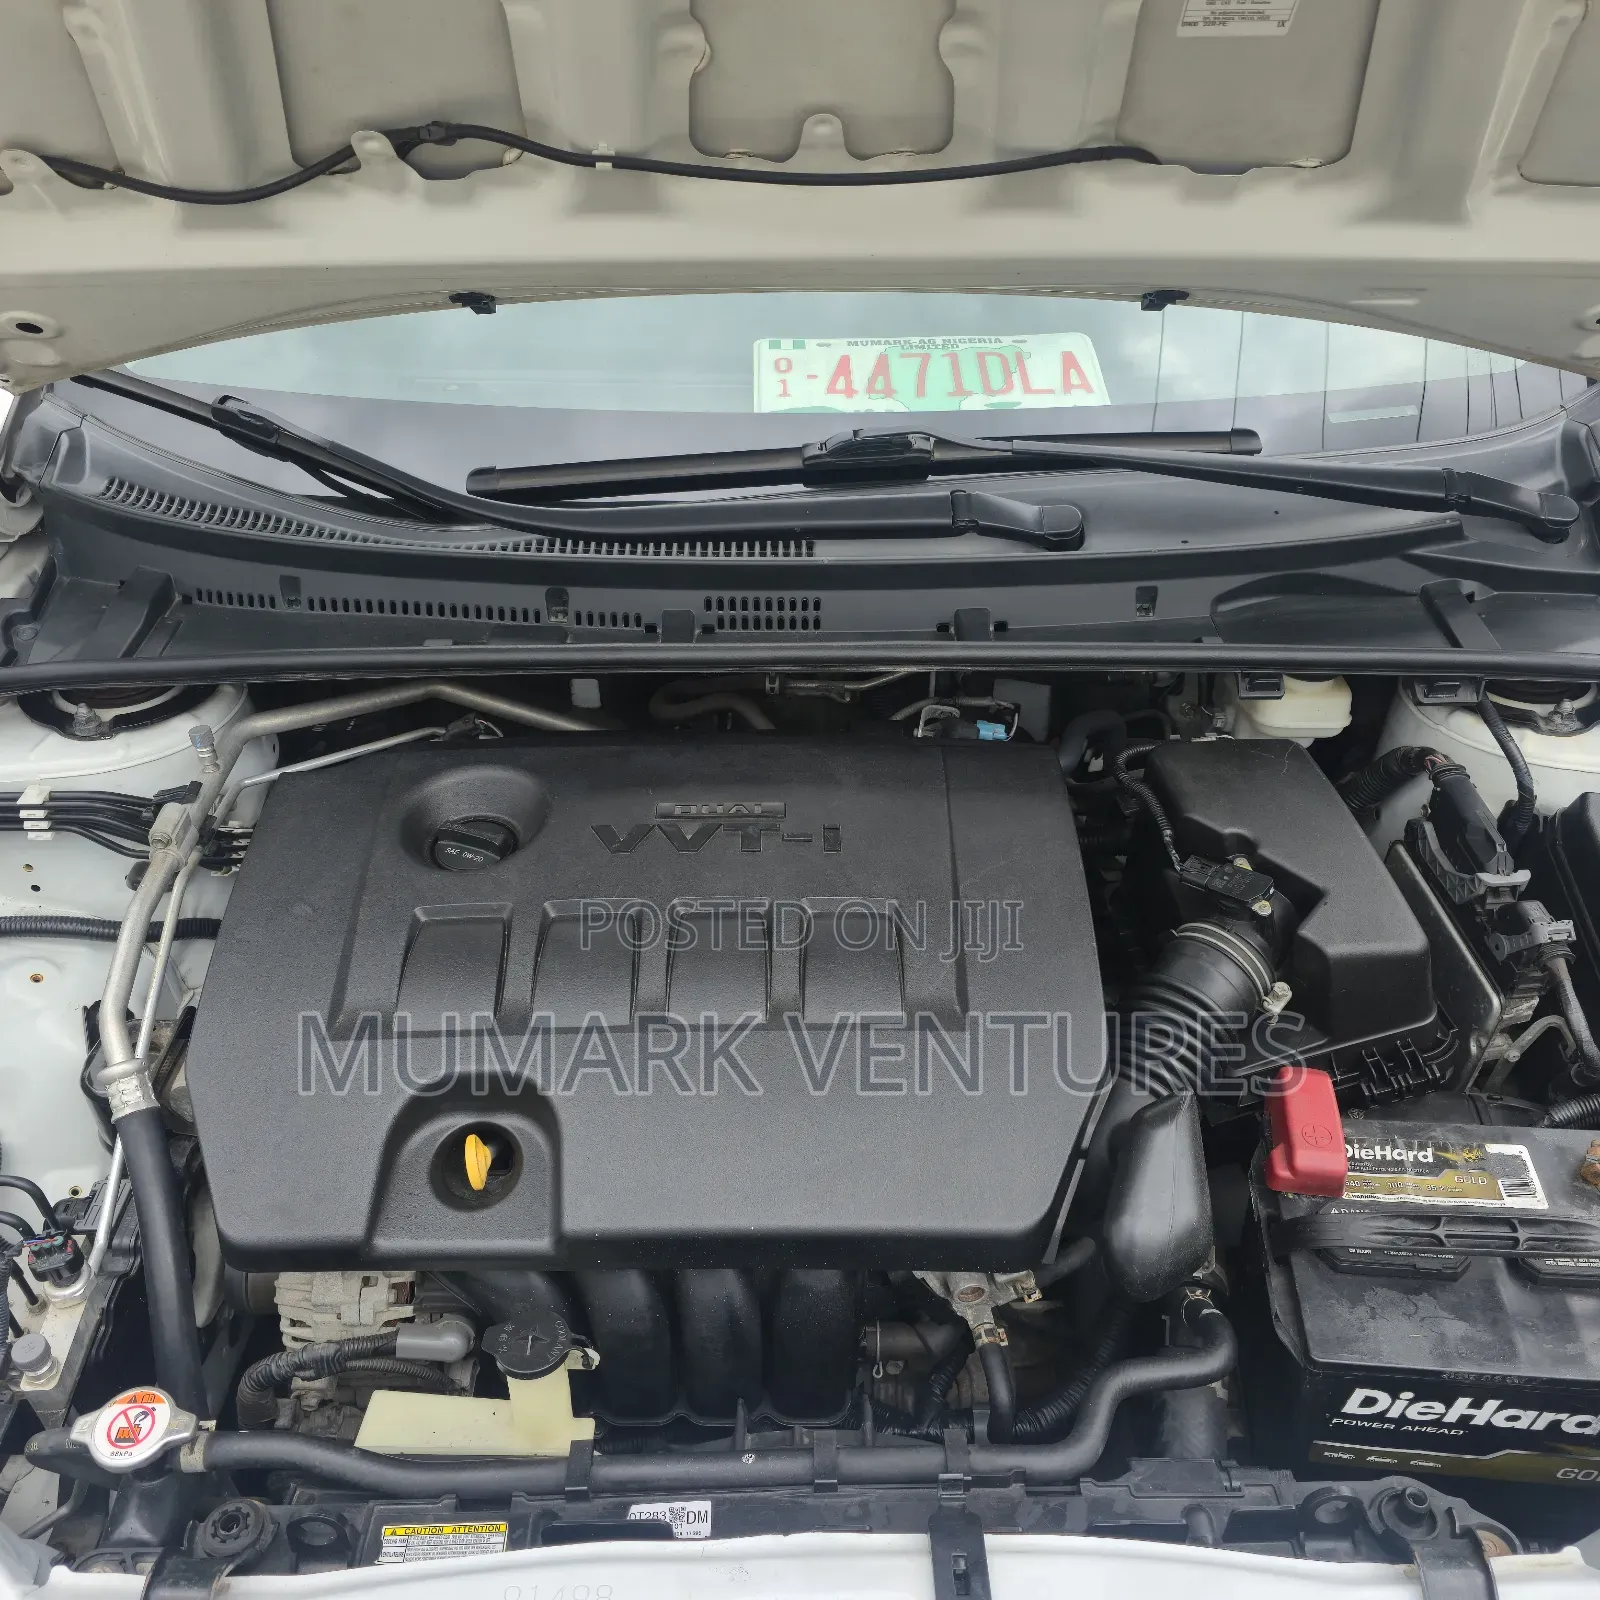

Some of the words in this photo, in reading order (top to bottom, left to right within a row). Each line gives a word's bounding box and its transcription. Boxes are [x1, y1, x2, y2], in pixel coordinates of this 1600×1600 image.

[846, 337, 937, 347] MUMARK-AG
[941, 336, 1004, 346] NIGERIA
[900, 343, 960, 351] LIMITED
[674, 802, 773, 815] DUAL
[444, 846, 461, 856] SAE
[461, 851, 485, 863] 0W-20
[1454, 1175, 1487, 1185] GOLD
[1331, 1418, 1396, 1431] POWER
[1400, 1424, 1464, 1436] AHEAD
[1556, 1467, 1600, 1483] GO
[686, 1510, 708, 1525] DM
[451, 1524, 501, 1533] ATTENTION
